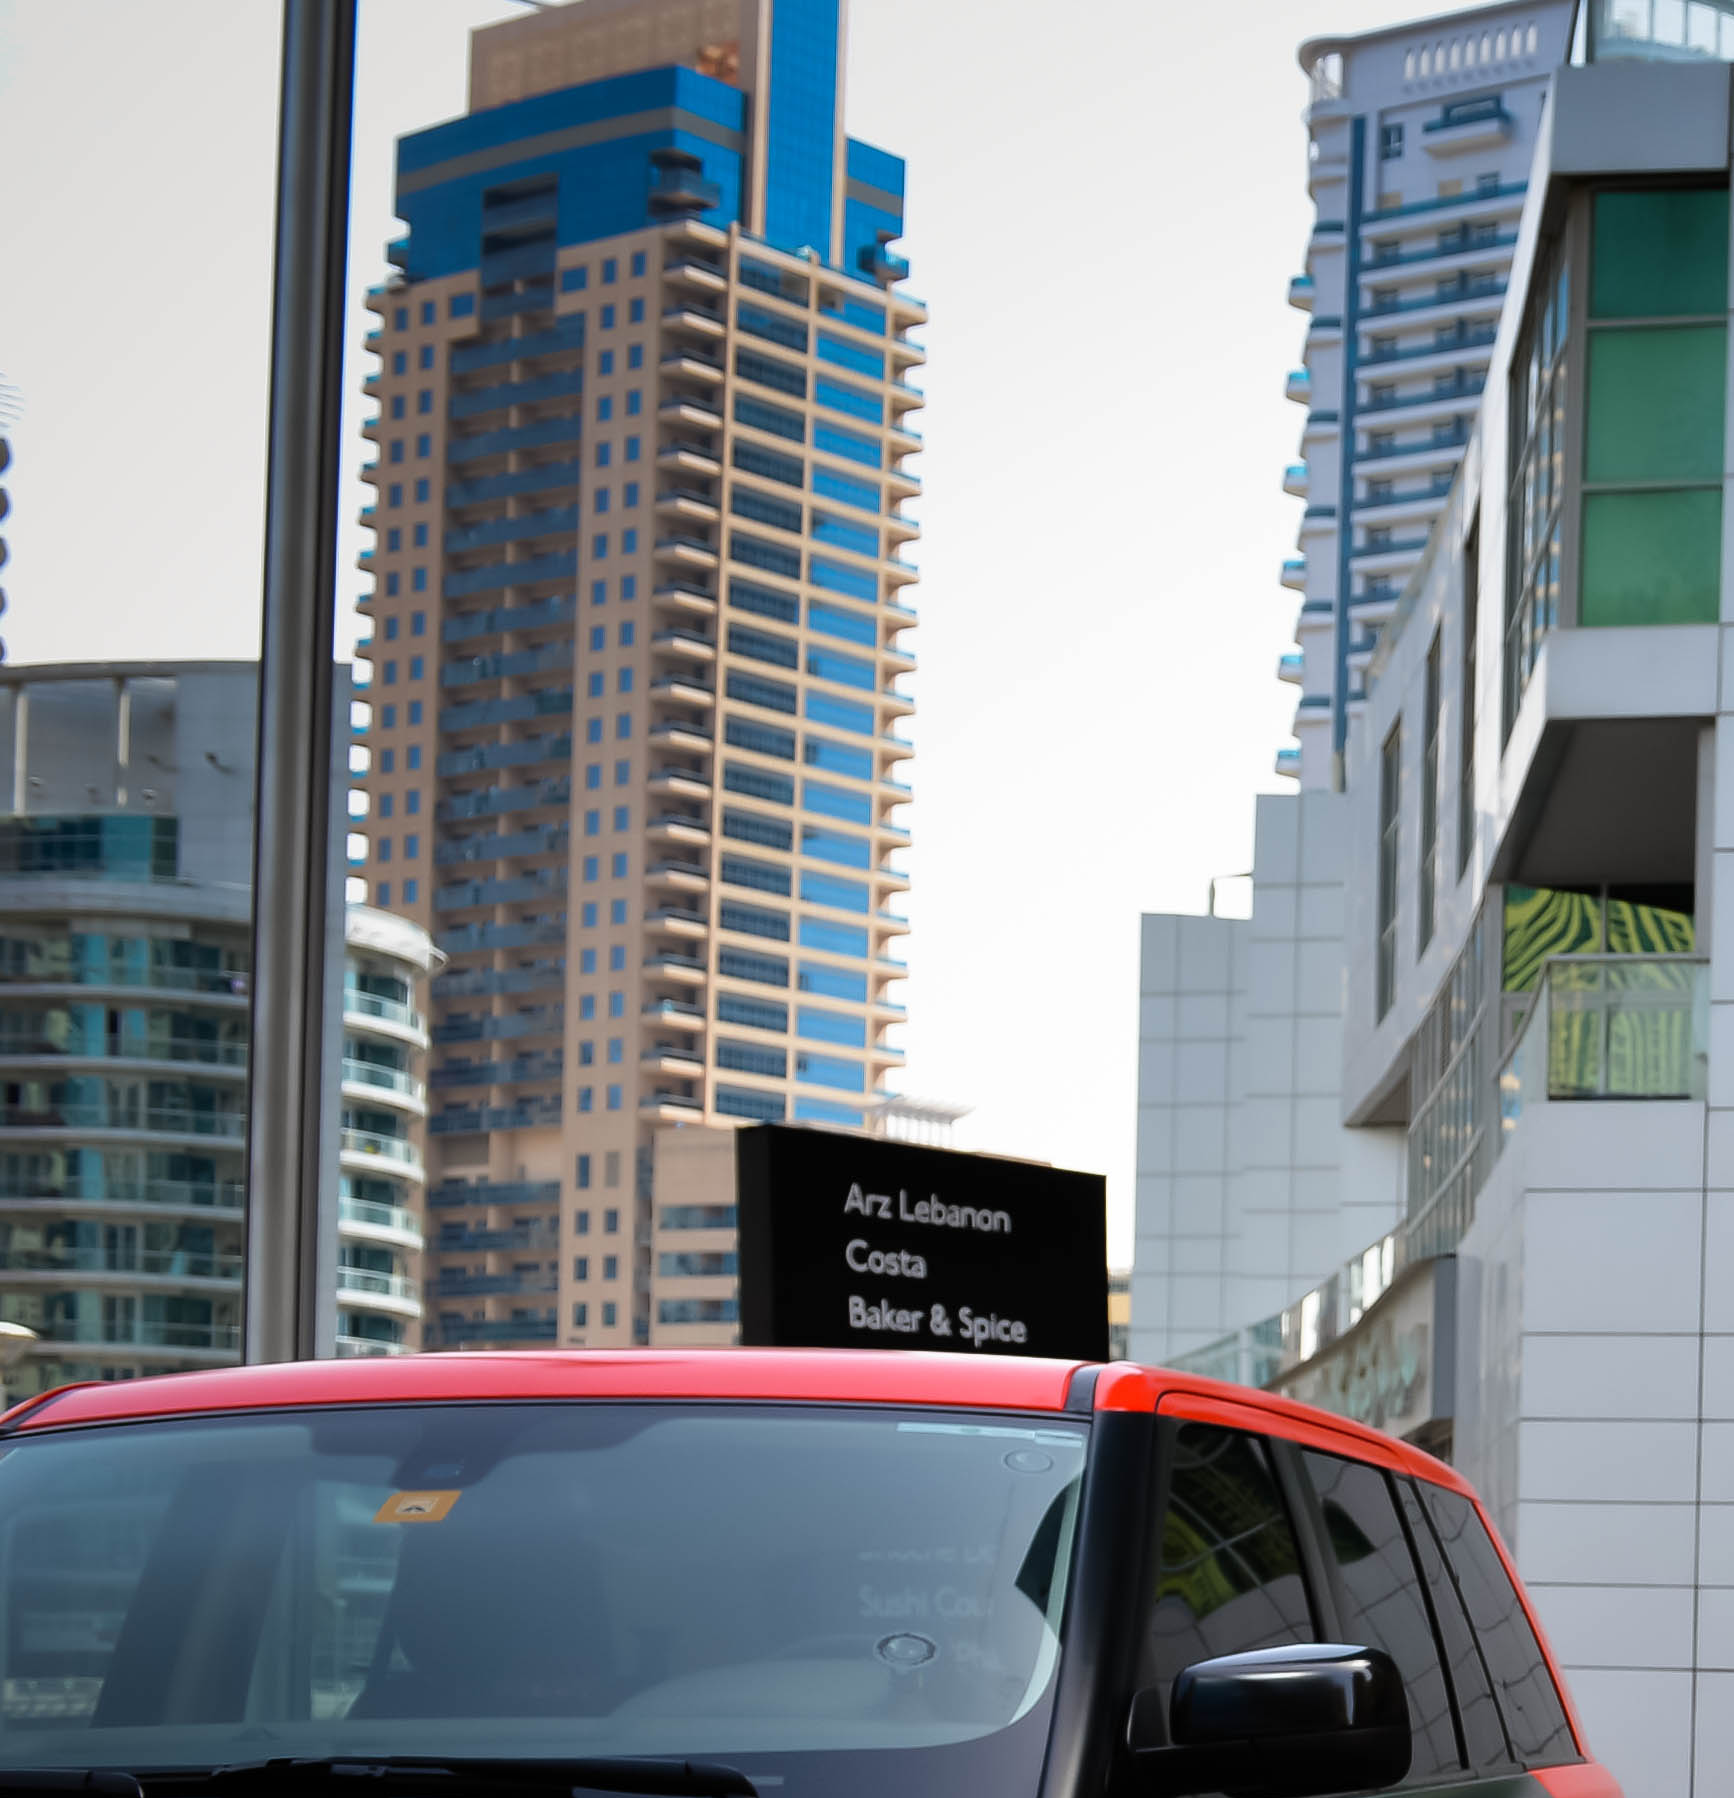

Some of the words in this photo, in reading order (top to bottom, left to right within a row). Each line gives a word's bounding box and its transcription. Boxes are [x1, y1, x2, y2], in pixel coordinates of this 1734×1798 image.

[844, 1182, 892, 1219] Arz
[899, 1188, 1012, 1233] Lebanon
[845, 1239, 927, 1278] Costa
[849, 1296, 924, 1332] Baker
[930, 1303, 952, 1336] &
[958, 1306, 1028, 1348] Spice
